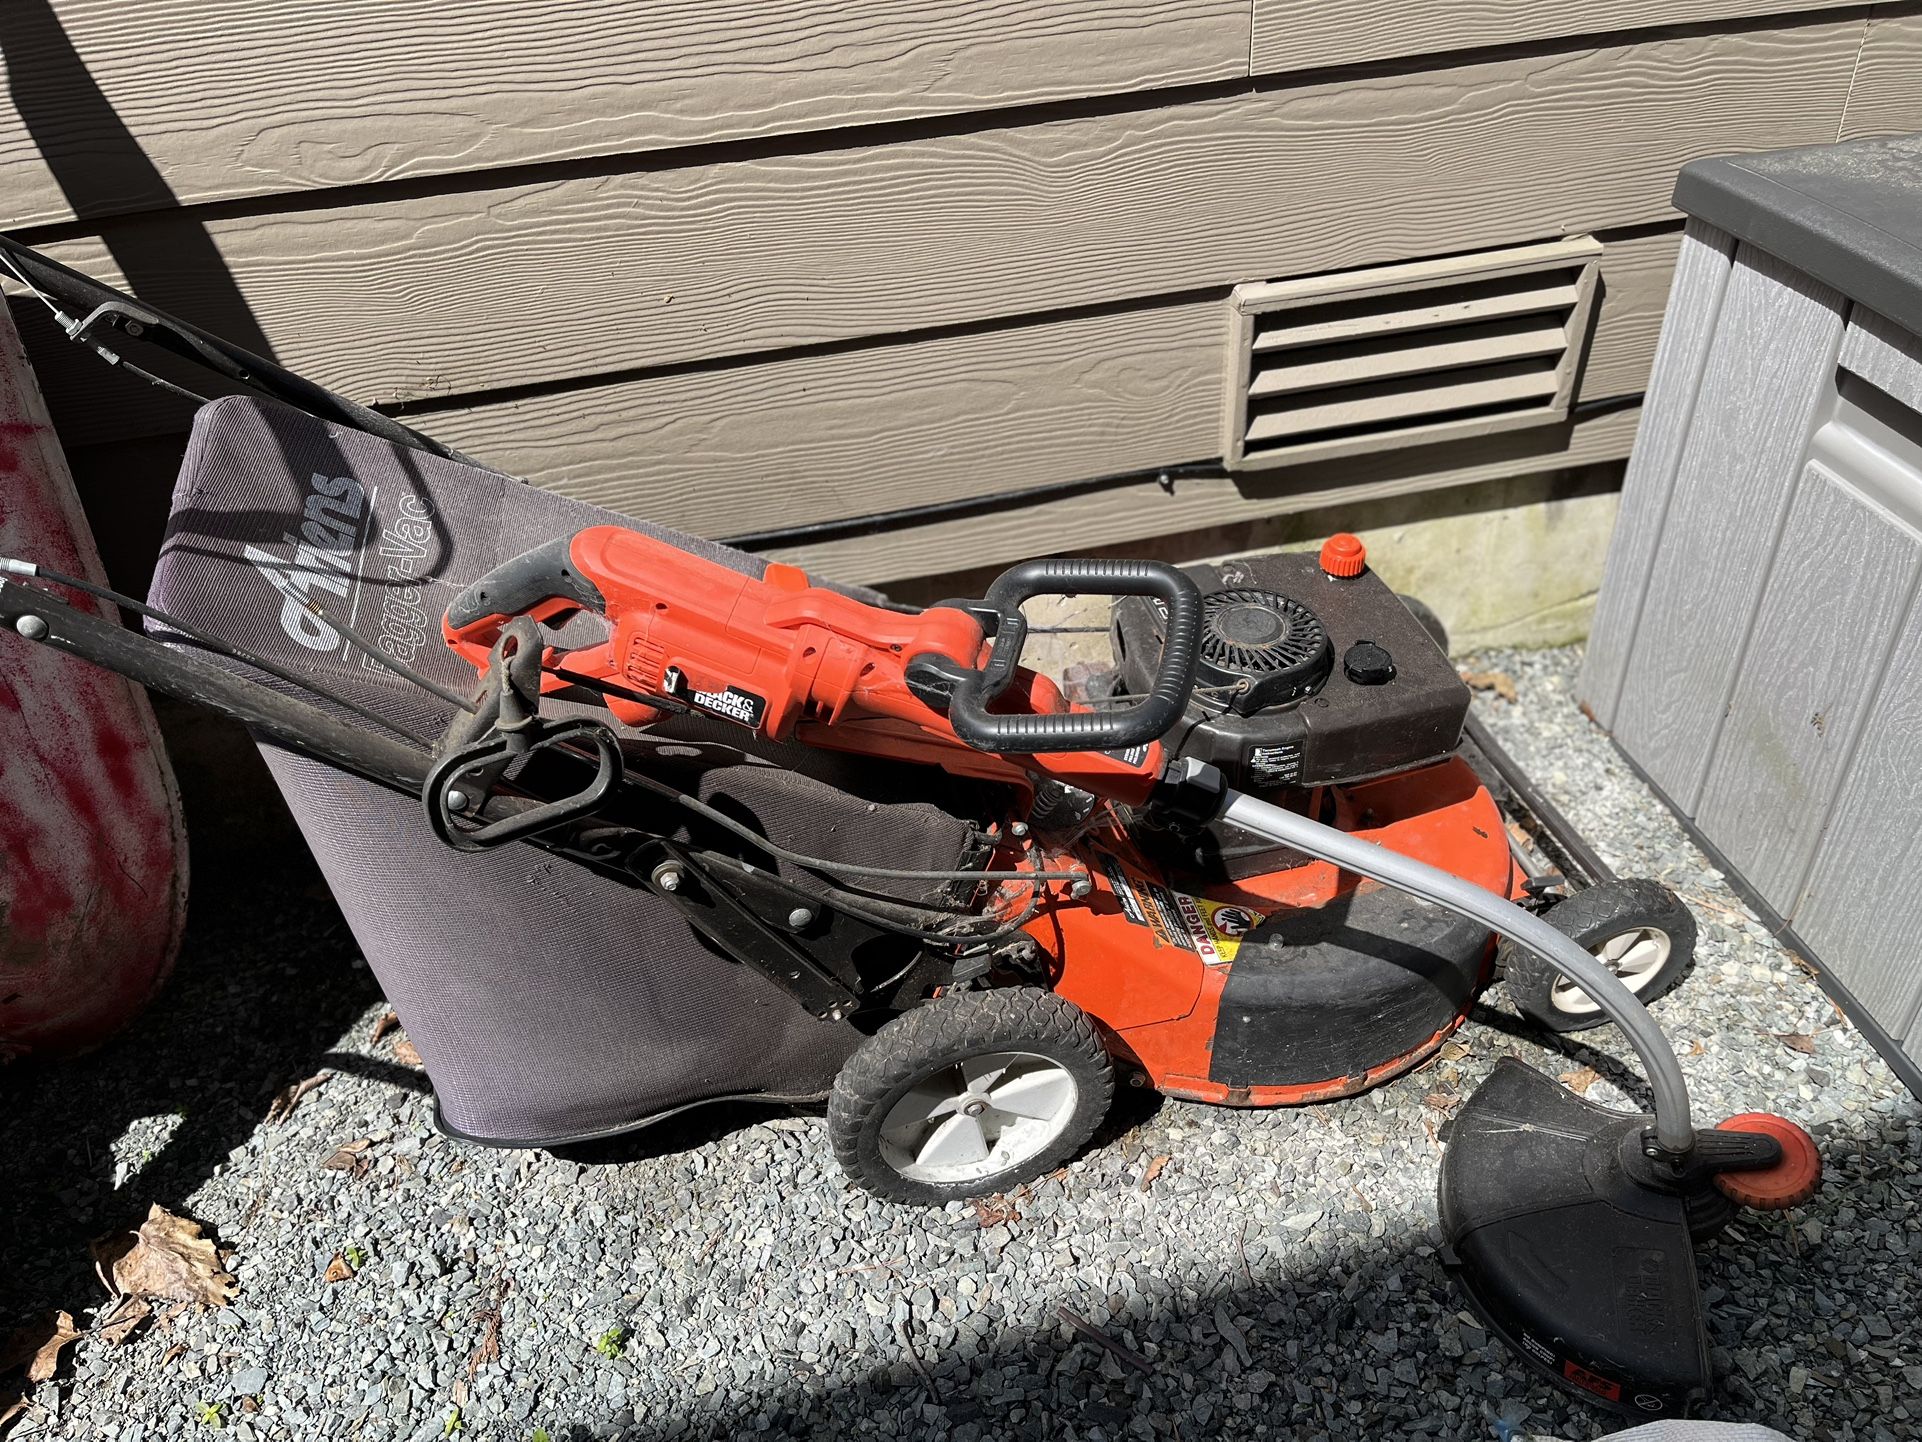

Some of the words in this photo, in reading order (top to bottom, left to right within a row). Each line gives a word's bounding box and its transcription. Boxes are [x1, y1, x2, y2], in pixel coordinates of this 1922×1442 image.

[244, 473, 365, 651] Ariens
[694, 692, 751, 721] DECKER
[1178, 895, 1215, 955] DANGER
